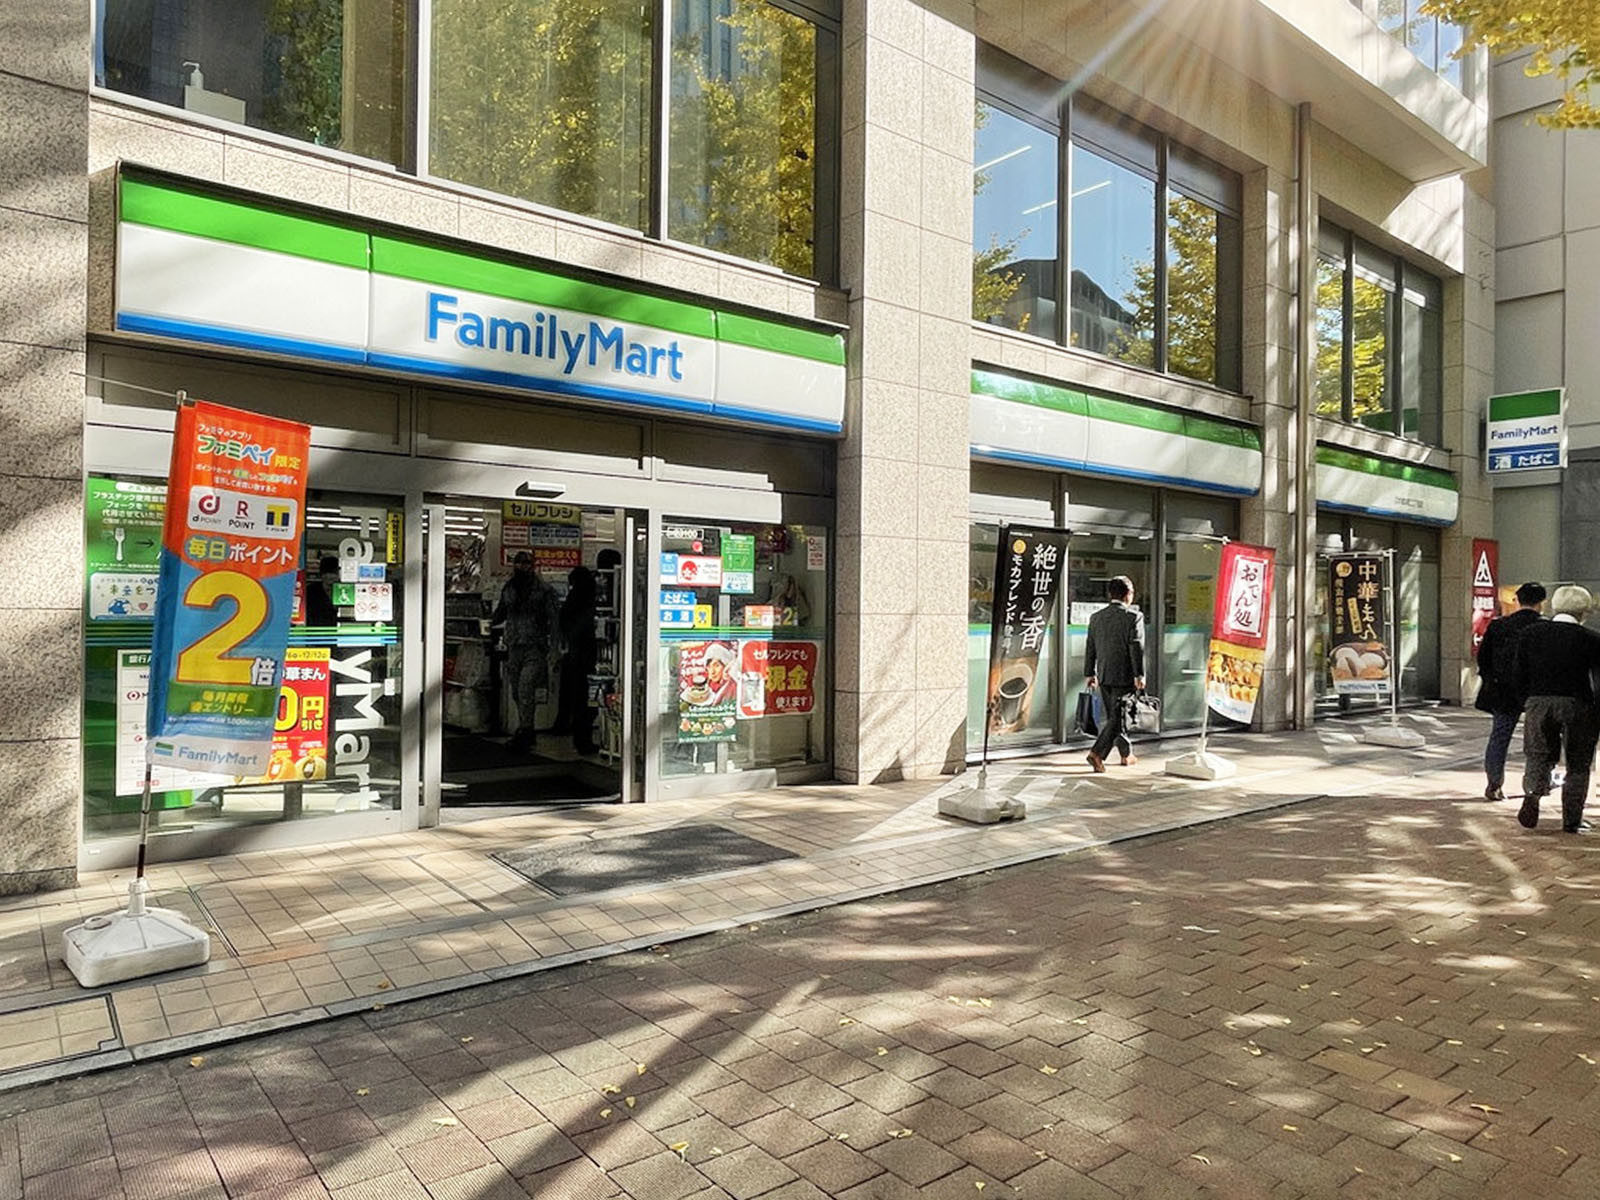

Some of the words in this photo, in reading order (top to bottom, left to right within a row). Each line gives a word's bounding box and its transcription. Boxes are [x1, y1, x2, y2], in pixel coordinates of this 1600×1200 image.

[427, 291, 684, 381] FamilyMart
[1490, 423, 1558, 441] FamilyMart
[197, 434, 276, 466] ファミペイ
[1495, 455, 1512, 469] 酒
[1517, 453, 1554, 467] たばこ
[228, 519, 255, 530] POINT
[1233, 564, 1261, 628] おでん処
[282, 667, 327, 682] 華まん
[178, 746, 258, 765] FamilyMart
